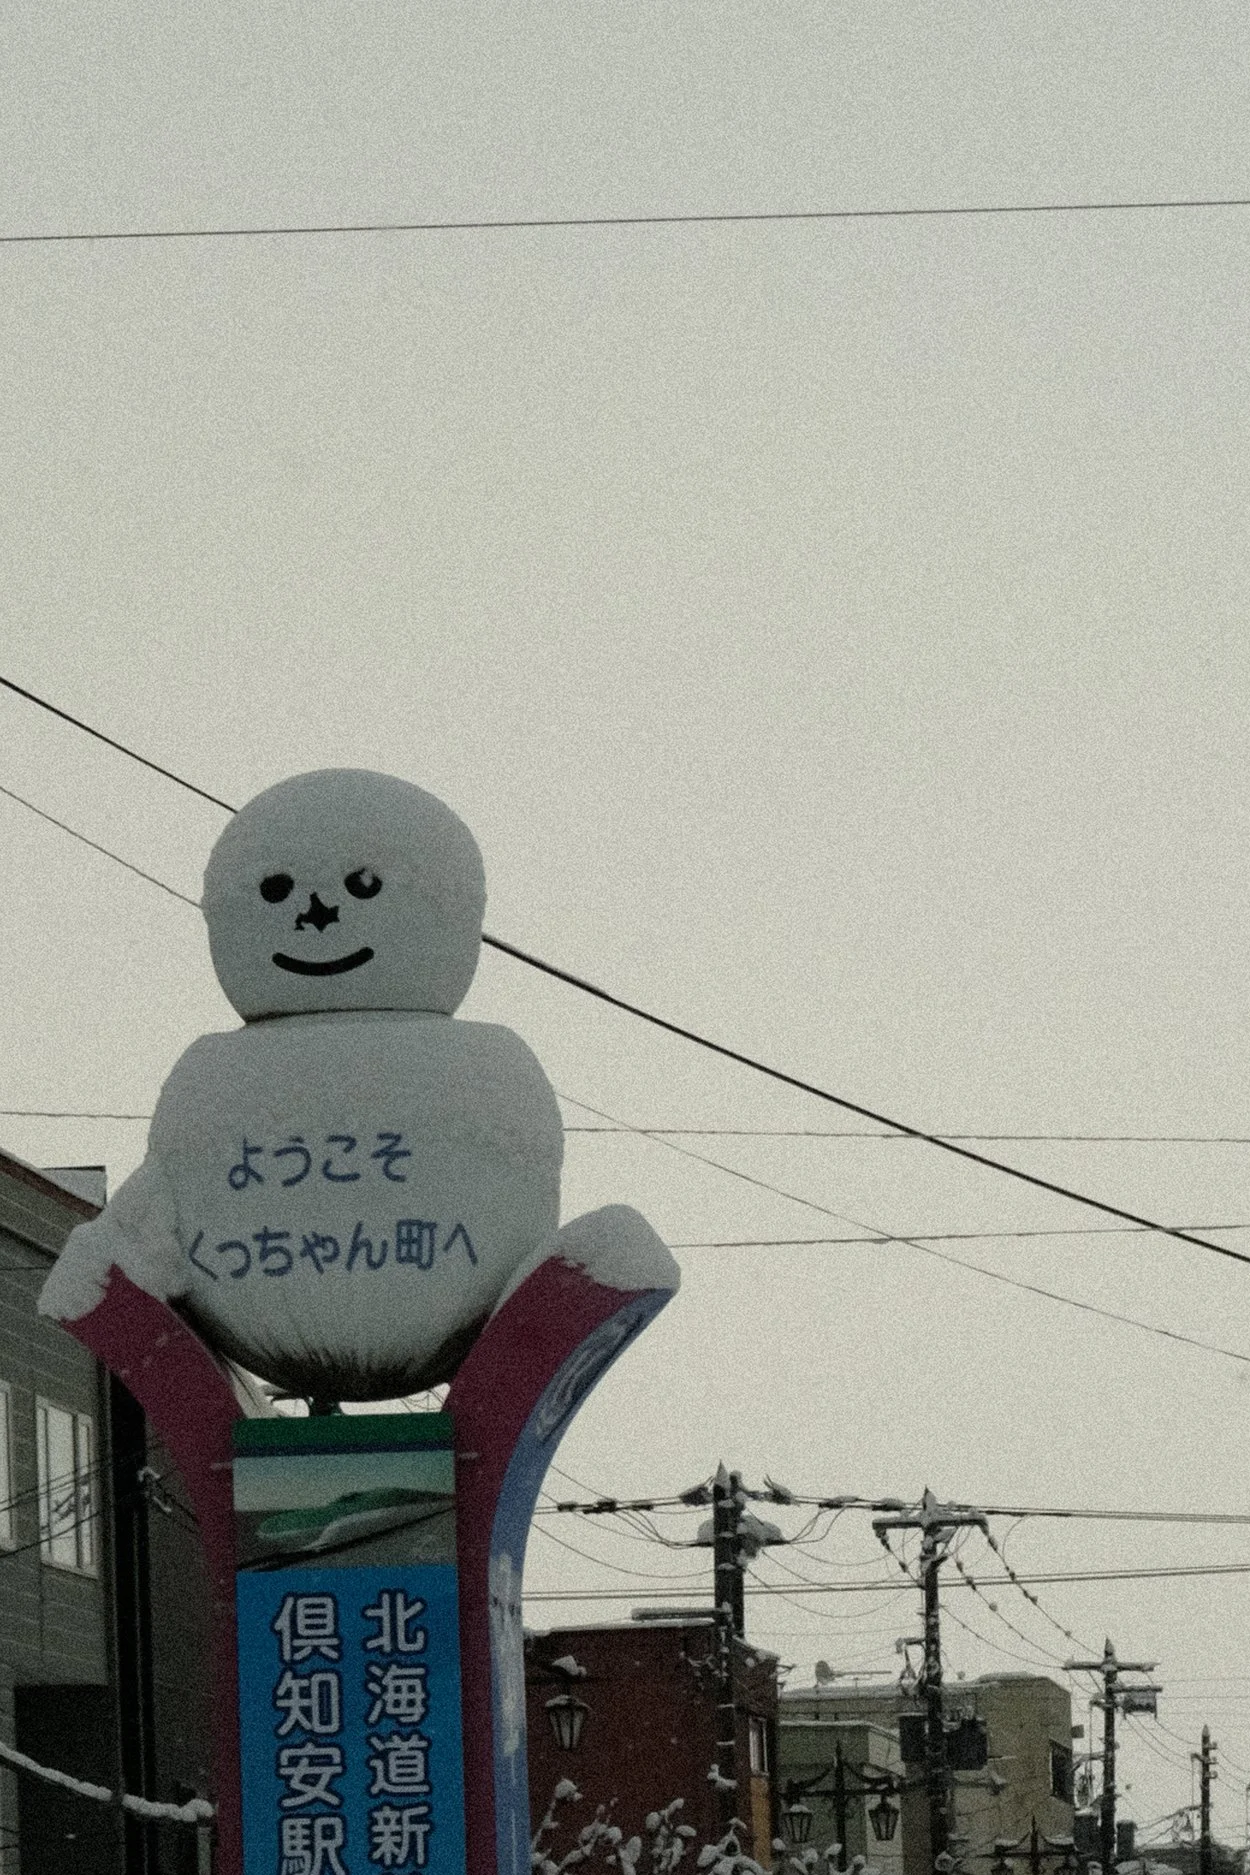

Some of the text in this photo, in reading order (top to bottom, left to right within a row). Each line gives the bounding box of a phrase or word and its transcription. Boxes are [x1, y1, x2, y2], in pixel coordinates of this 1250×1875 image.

[227, 1132, 414, 1190] ようこそ
[186, 1218, 480, 1281] くっちゃん町へ
